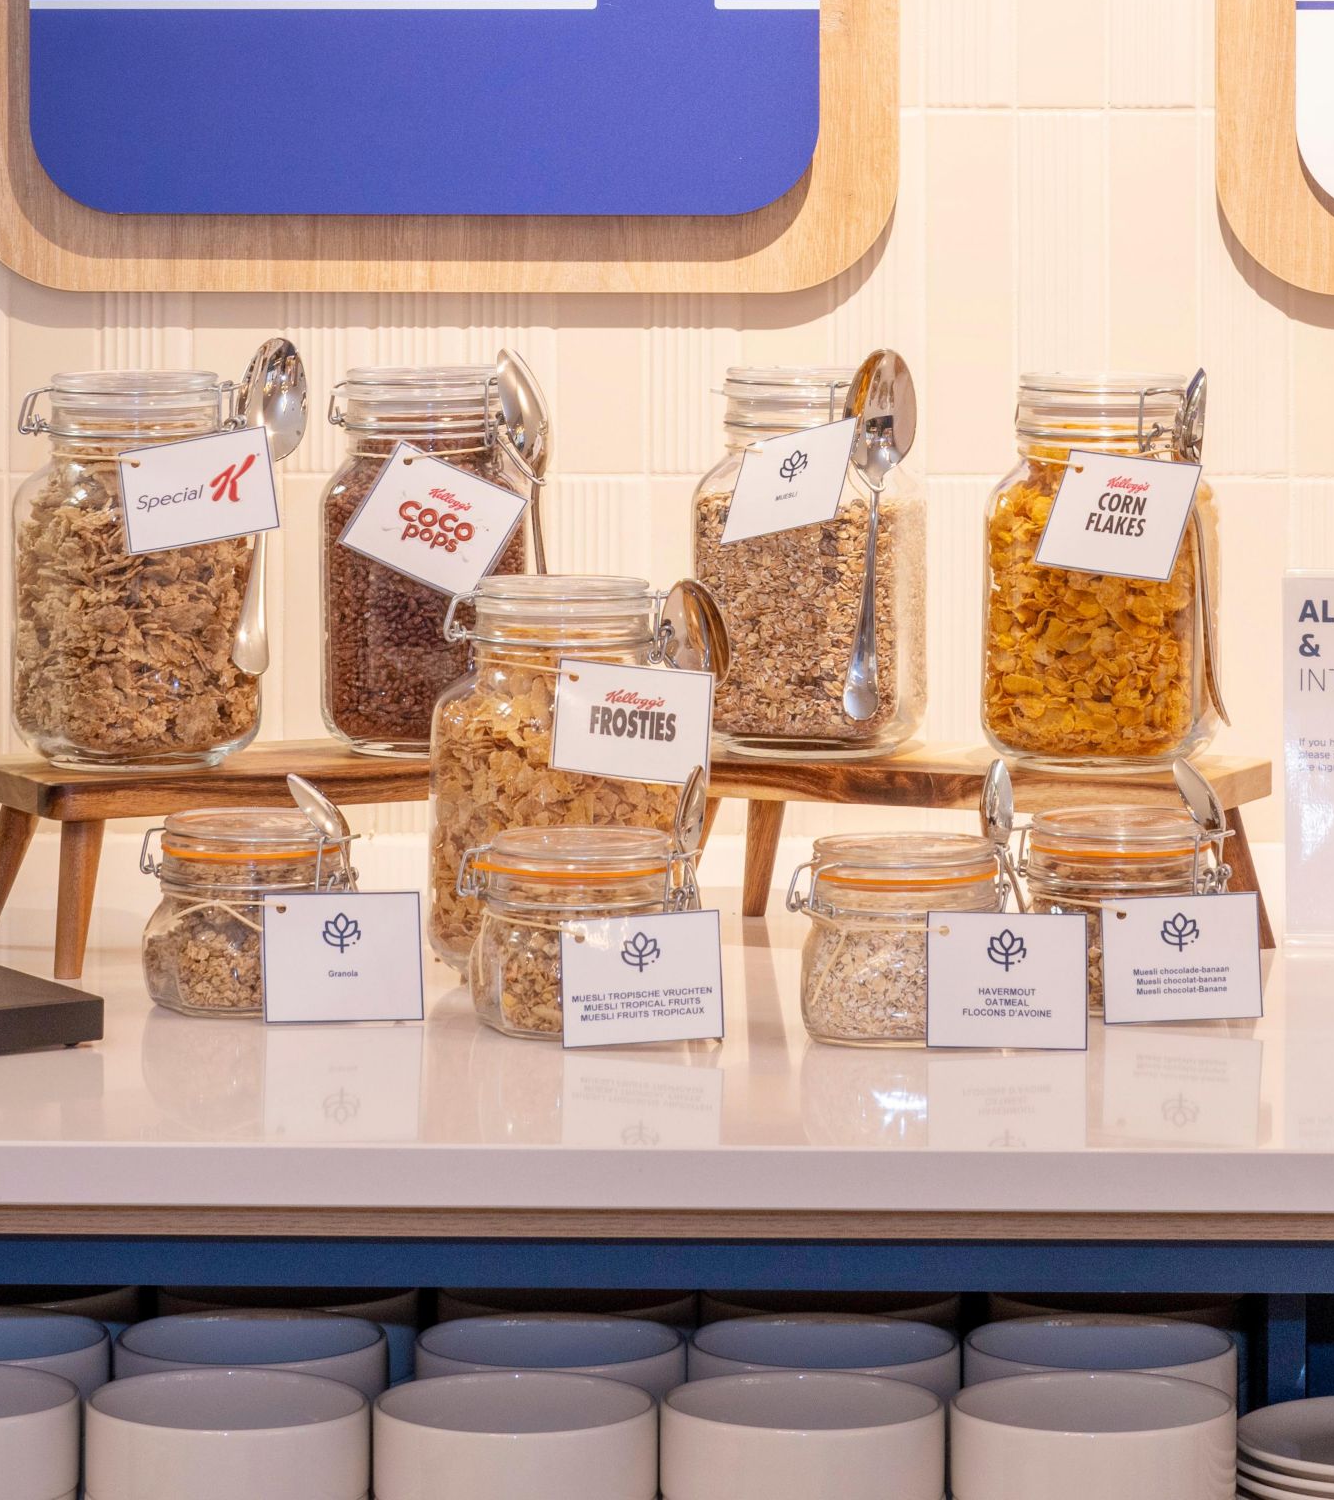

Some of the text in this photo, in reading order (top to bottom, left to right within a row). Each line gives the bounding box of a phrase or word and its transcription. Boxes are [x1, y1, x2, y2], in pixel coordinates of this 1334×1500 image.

[136, 454, 256, 512] Special K
[775, 492, 798, 501] MUESLI
[1098, 493, 1147, 516] CORN
[1085, 512, 1146, 537] FLAKES
[401, 523, 459, 553] pops
[1298, 633, 1321, 657] &
[589, 705, 677, 742] FROSTIES
[1308, 740, 1326, 748] you
[328, 969, 359, 978] Granola
[1133, 966, 1230, 976] Muesli chocolade-banaan
[1163, 975, 1227, 984] chocolat-banana
[572, 987, 713, 1003] MUESLI TROPISCHE VRUCHTEN
[978, 988, 1037, 996] HAVERMOUT
[1163, 985, 1228, 994] chocolat-Banane
[584, 997, 701, 1012] MUESLI TROPICAL FRUITS
[985, 998, 1029, 1007] OATMEAL
[580, 1007, 705, 1022] MUESLI FRUITS TROPICAUX
[962, 1008, 1052, 1018] FLOCONS D'AVOINE
